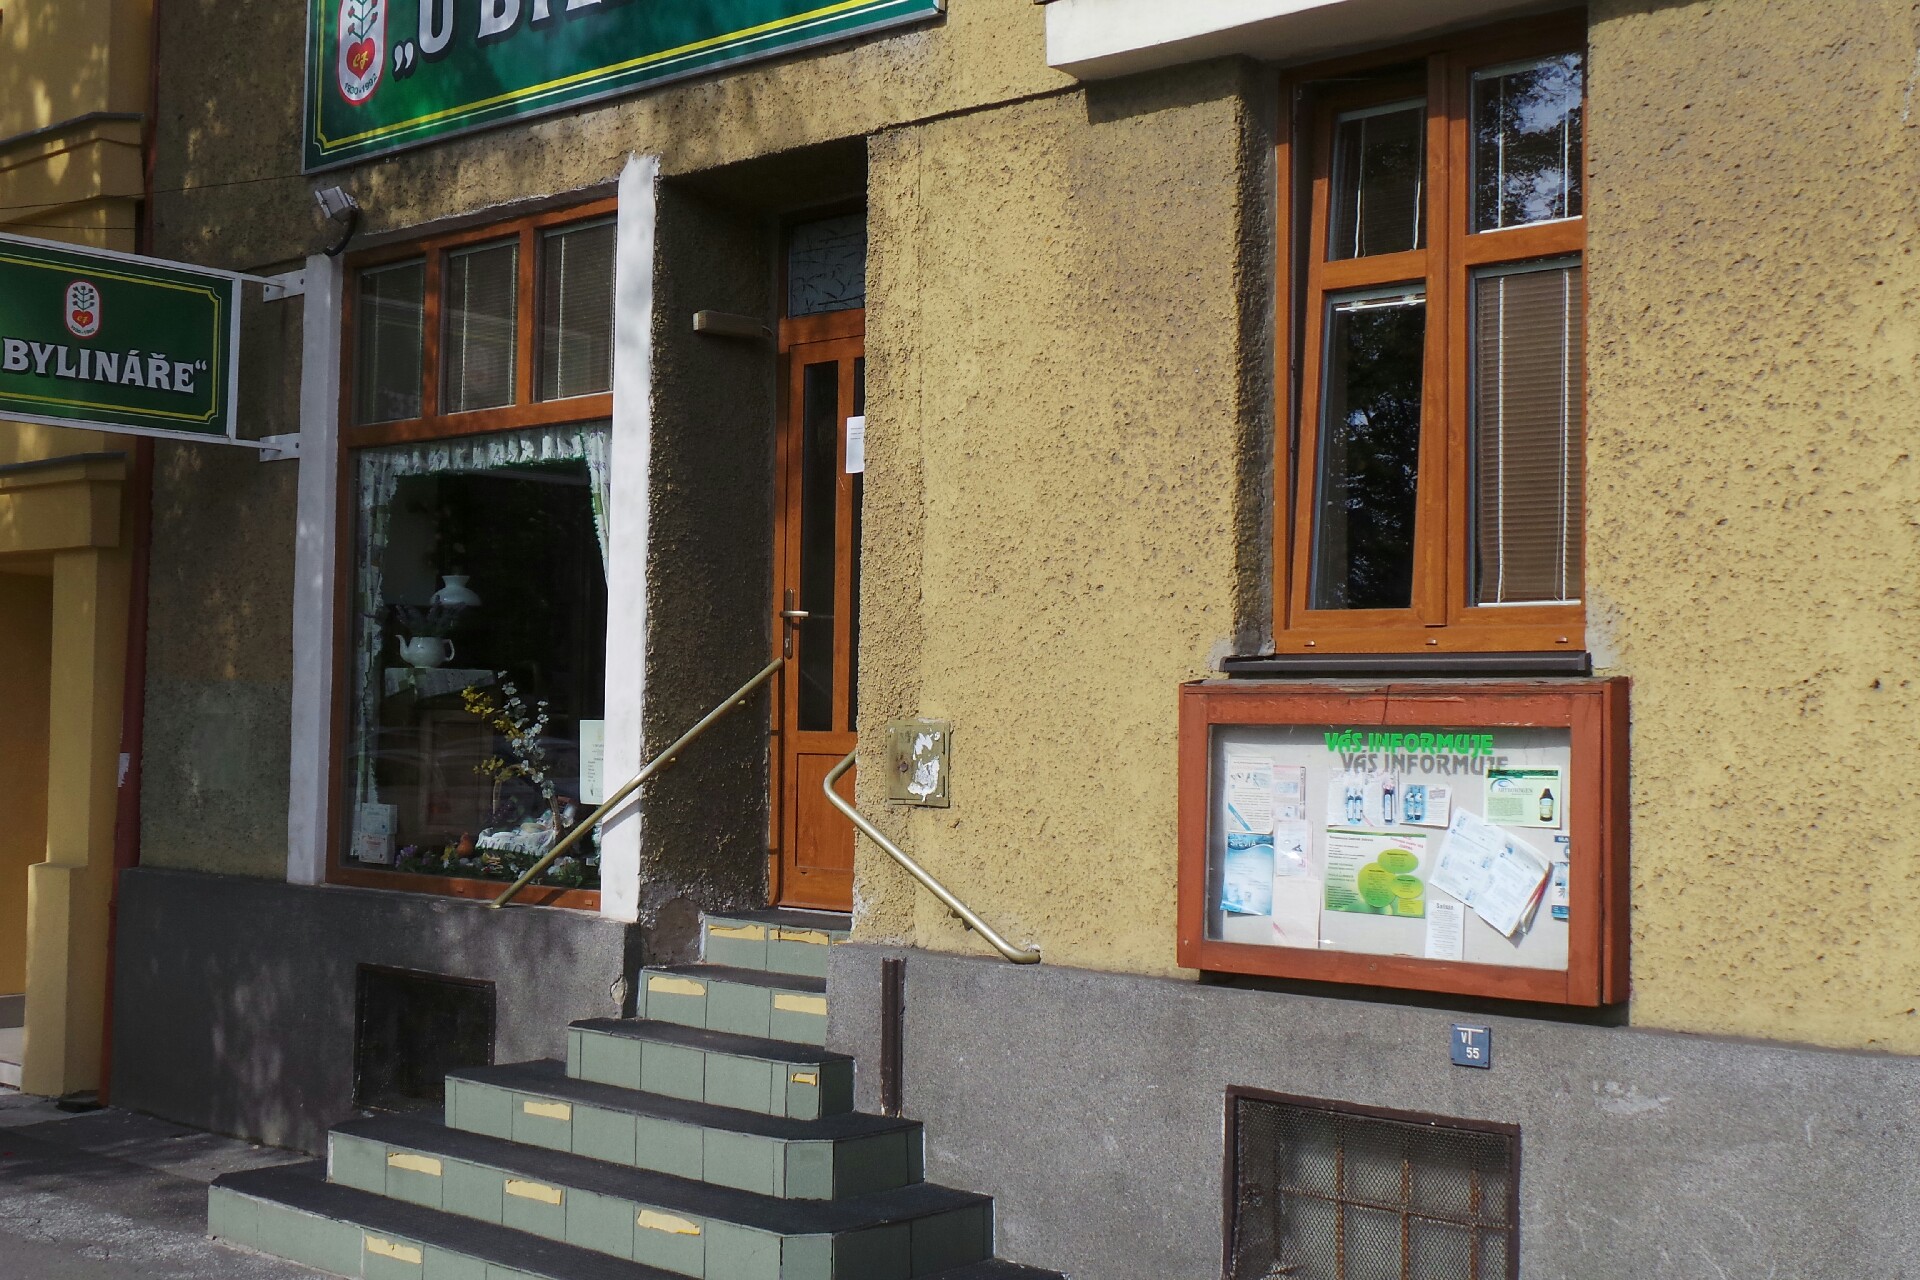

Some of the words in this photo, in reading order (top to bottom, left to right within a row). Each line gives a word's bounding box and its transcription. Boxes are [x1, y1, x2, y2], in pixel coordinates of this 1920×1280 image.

[1324, 730, 1363, 754] VÁS
[1369, 732, 1494, 758] INFORMUJE
[1466, 1046, 1480, 1059] 55
